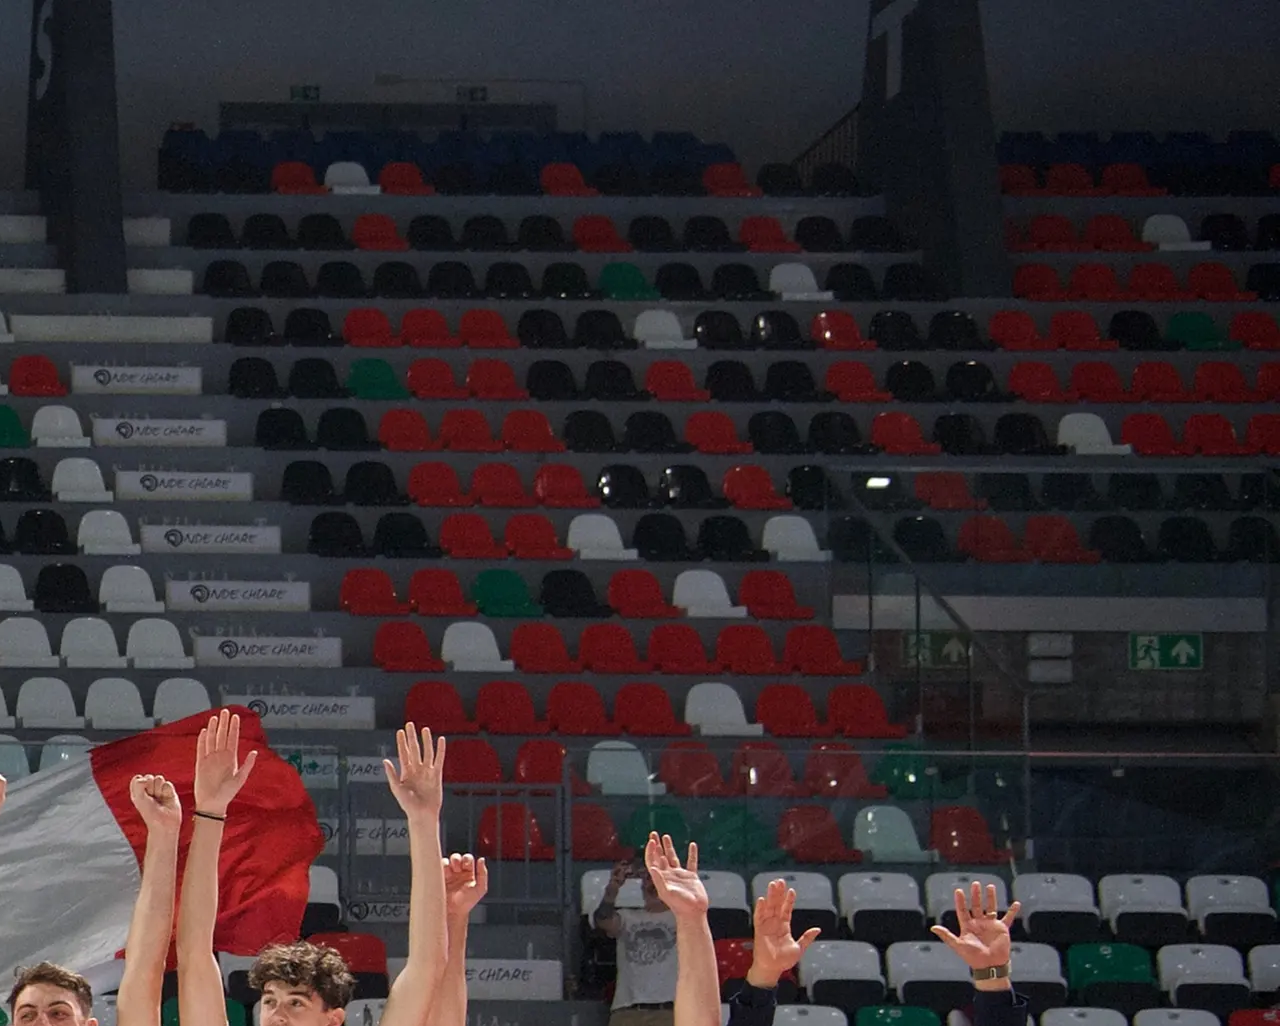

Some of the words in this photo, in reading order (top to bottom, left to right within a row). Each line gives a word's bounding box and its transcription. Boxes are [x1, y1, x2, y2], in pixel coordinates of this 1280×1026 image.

[140, 373, 180, 384] CHIARE
[163, 425, 204, 436] CHIARE
[188, 477, 231, 489] CHIARE
[214, 532, 258, 545] CHIARE
[242, 589, 288, 600] CHIARE
[271, 645, 318, 656] CHIARE
[301, 704, 349, 716] CHIARE
